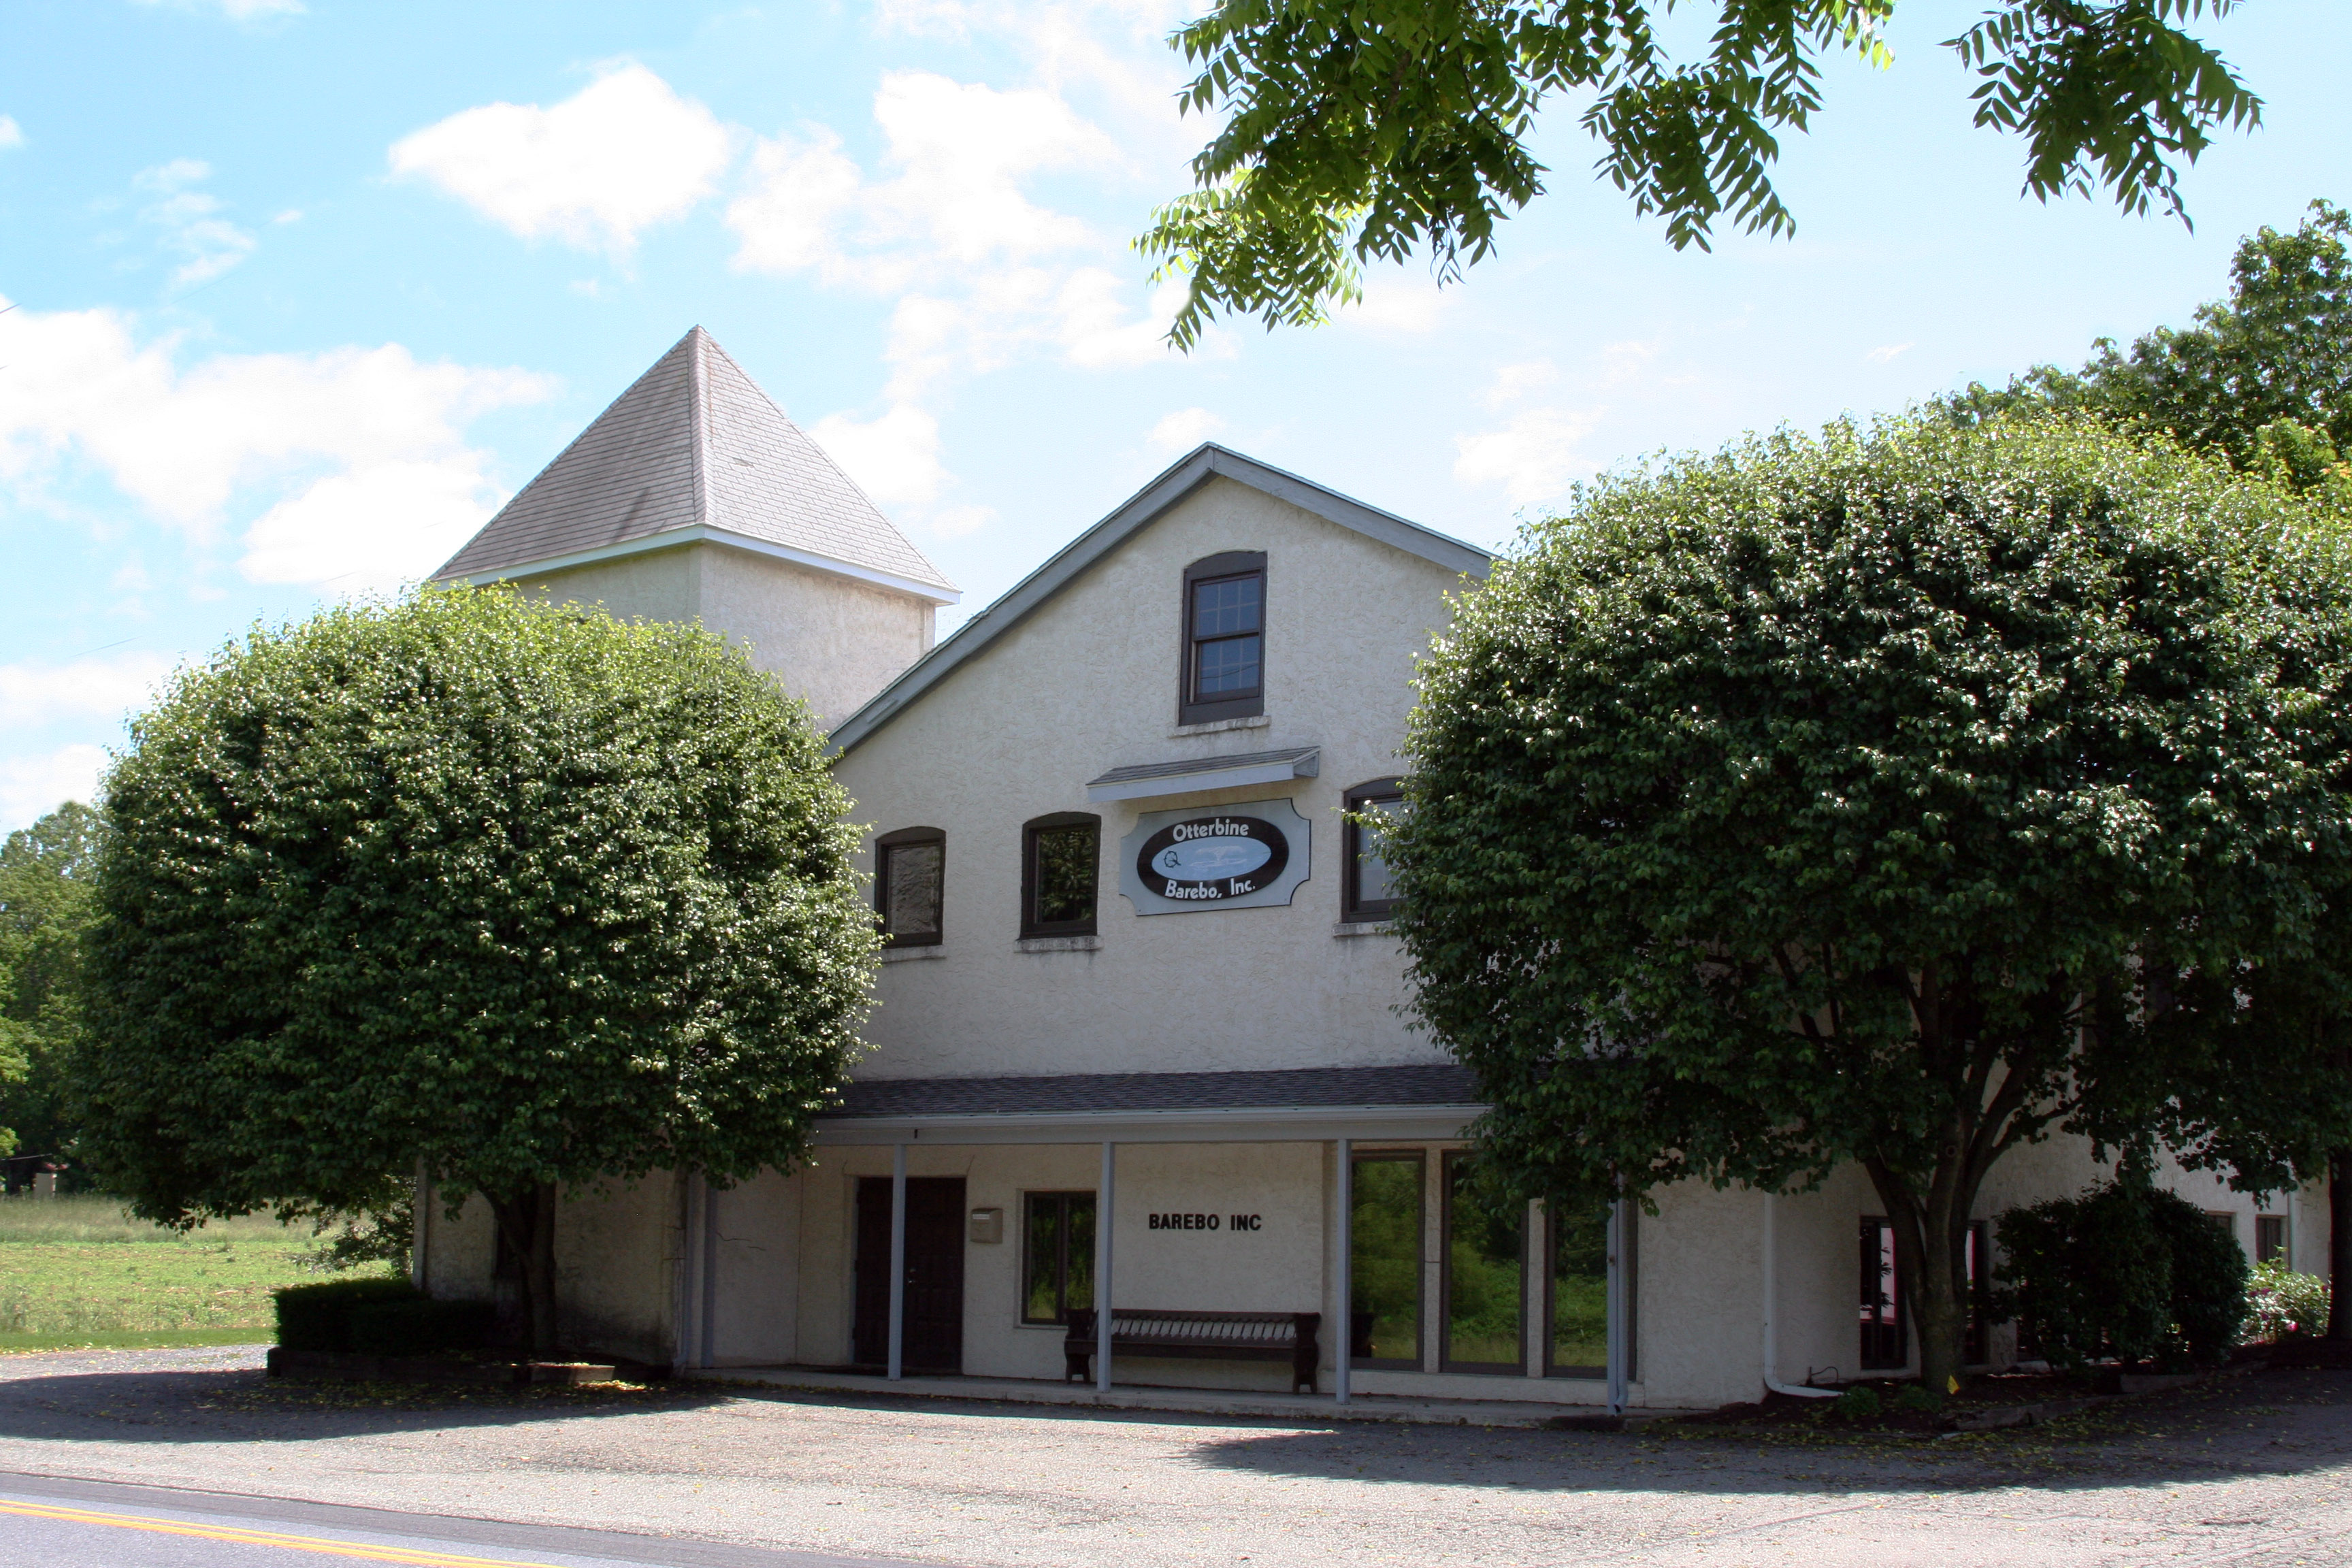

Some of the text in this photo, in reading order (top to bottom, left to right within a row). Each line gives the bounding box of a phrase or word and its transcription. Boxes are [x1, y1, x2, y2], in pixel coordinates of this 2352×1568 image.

[1173, 818, 1249, 841] Otterbine
[1165, 878, 1256, 900] Barebo, Inc.
[1149, 1213, 1262, 1230] BAREBO INC
